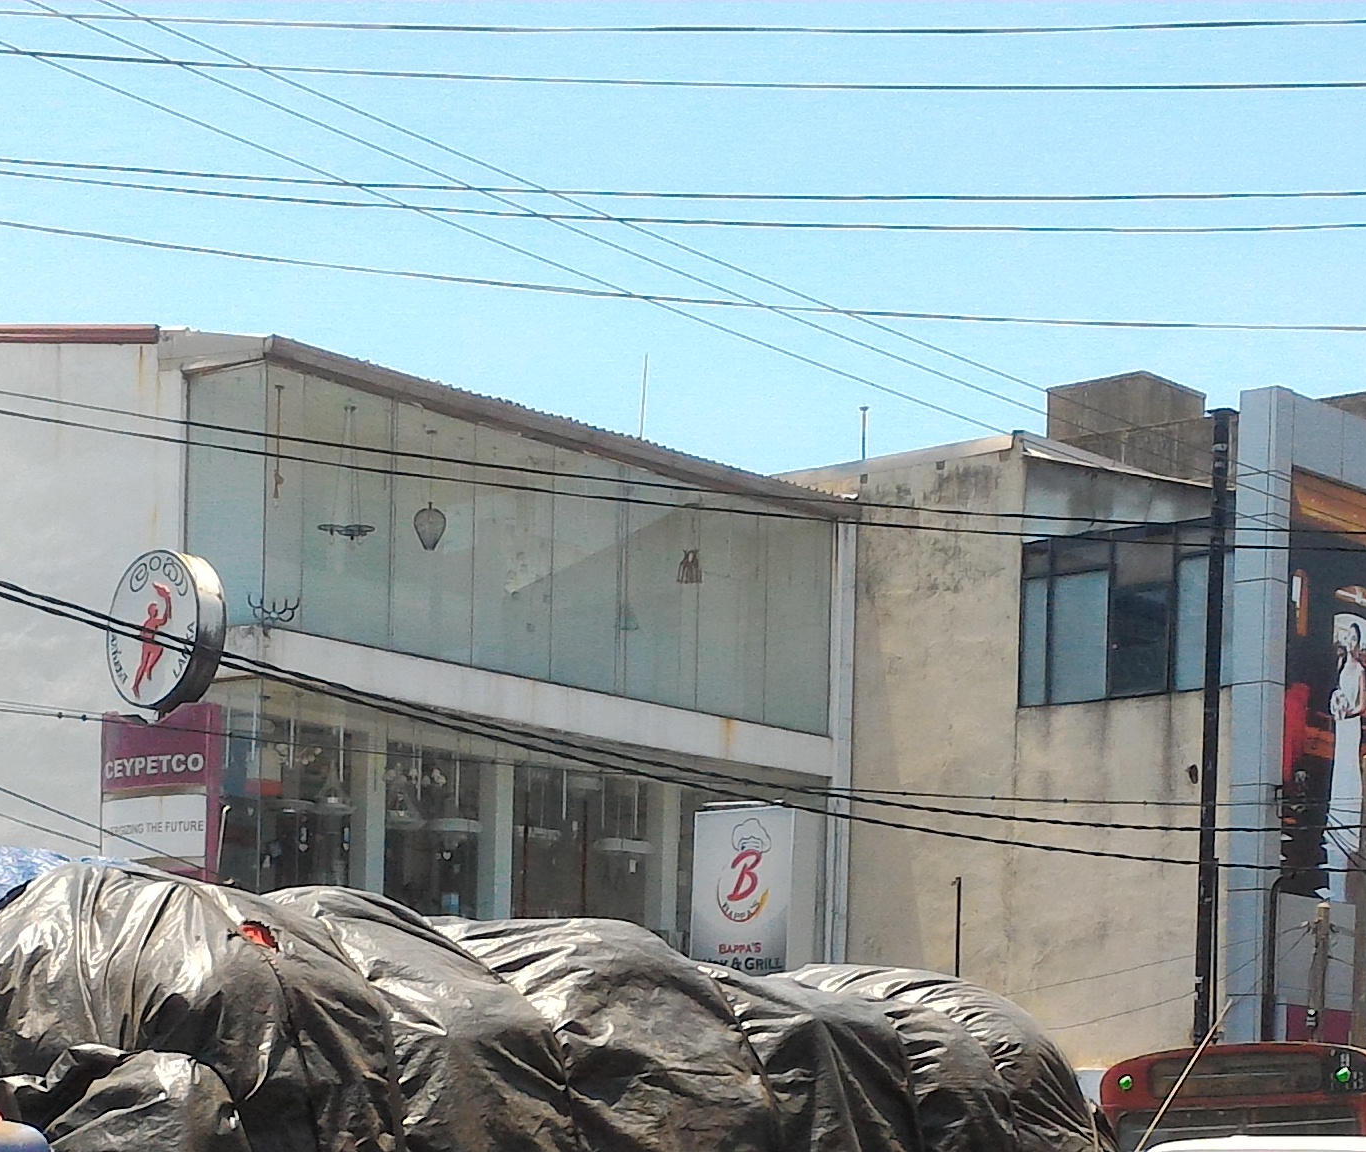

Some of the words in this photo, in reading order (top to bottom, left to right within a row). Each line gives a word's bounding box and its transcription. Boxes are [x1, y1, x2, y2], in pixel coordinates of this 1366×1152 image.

[105, 753, 205, 779] CEYPETCO
[146, 821, 163, 833] THE
[165, 820, 204, 833] FUTURE
[718, 942, 762, 955] BAPPA'S
[744, 956, 783, 971] GRILL
